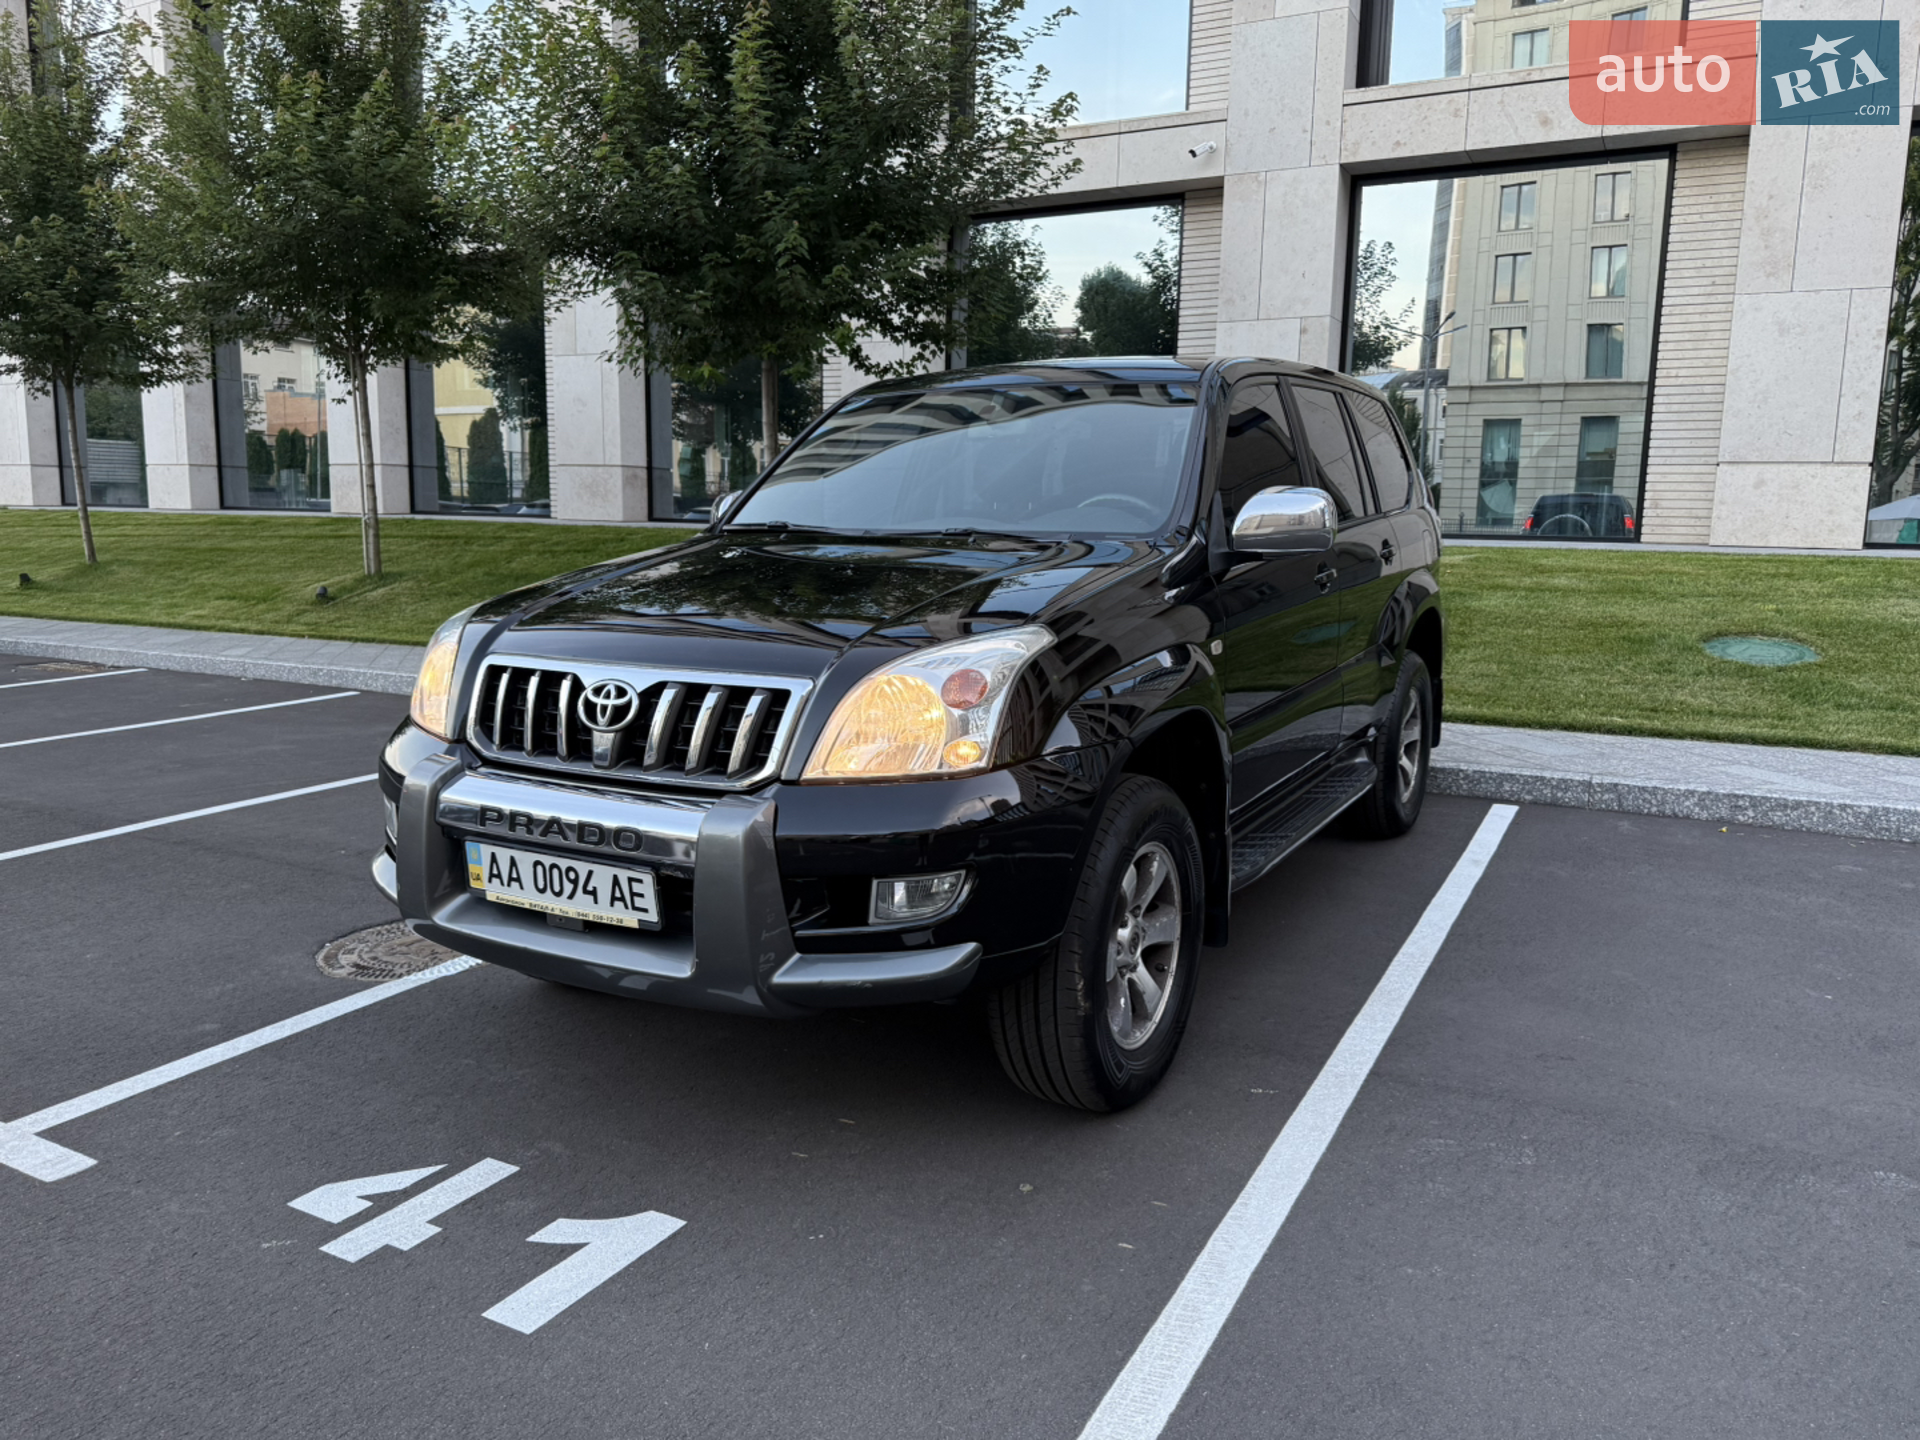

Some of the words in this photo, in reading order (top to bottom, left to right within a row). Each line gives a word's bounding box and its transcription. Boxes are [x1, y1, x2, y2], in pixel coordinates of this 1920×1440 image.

[477, 804, 644, 852] PRADO
[470, 871, 483, 883] UA
[488, 851, 525, 890] AA
[532, 860, 599, 905] 0094
[609, 874, 650, 914] AE
[287, 1157, 688, 1335] 41
